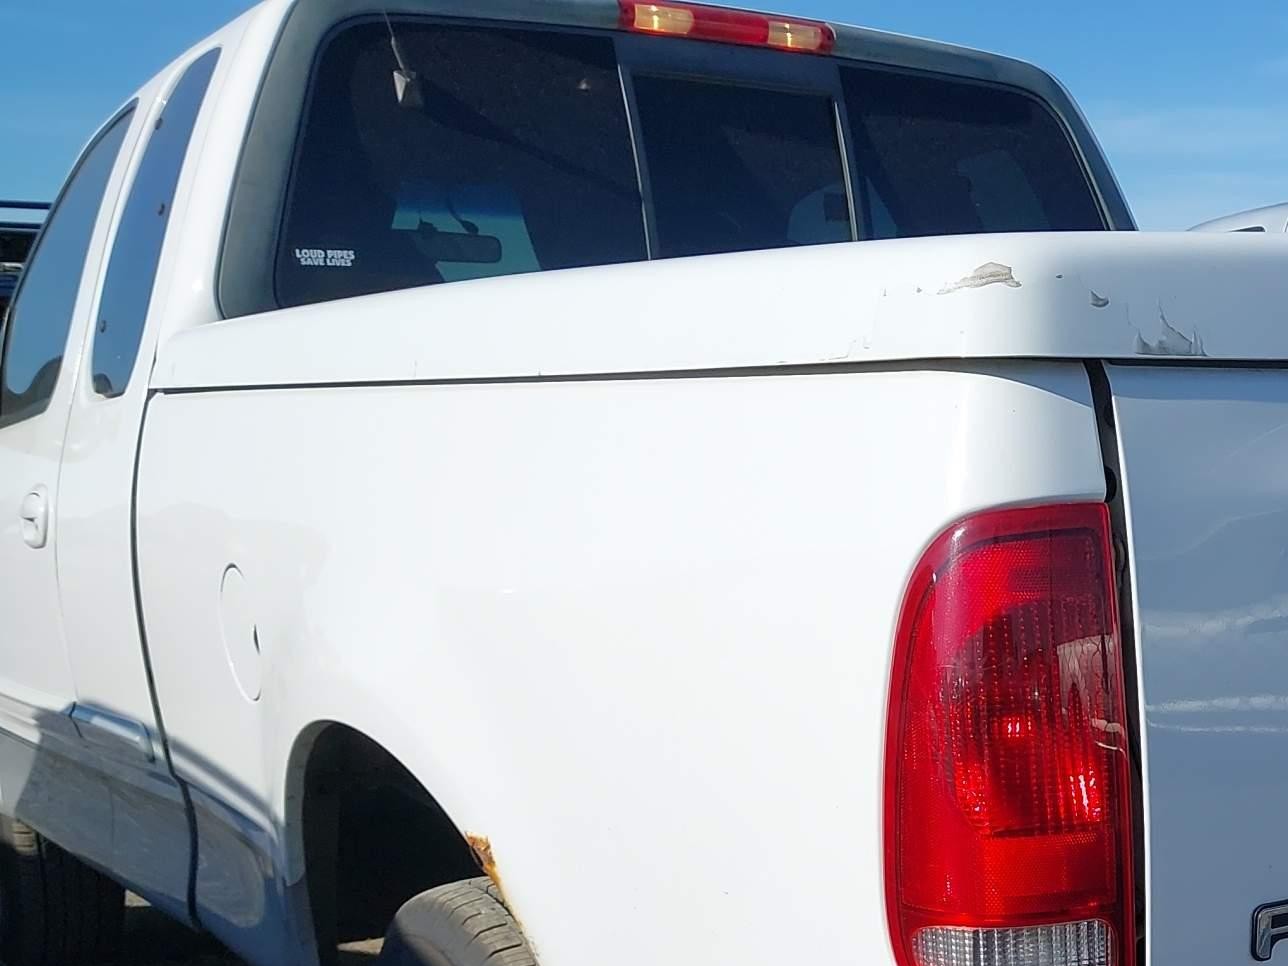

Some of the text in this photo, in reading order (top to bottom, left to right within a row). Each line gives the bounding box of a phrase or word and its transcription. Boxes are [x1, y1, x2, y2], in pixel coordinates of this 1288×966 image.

[295, 248, 355, 260] LOUD PIPES
[300, 257, 352, 267] SAVE LIVES
